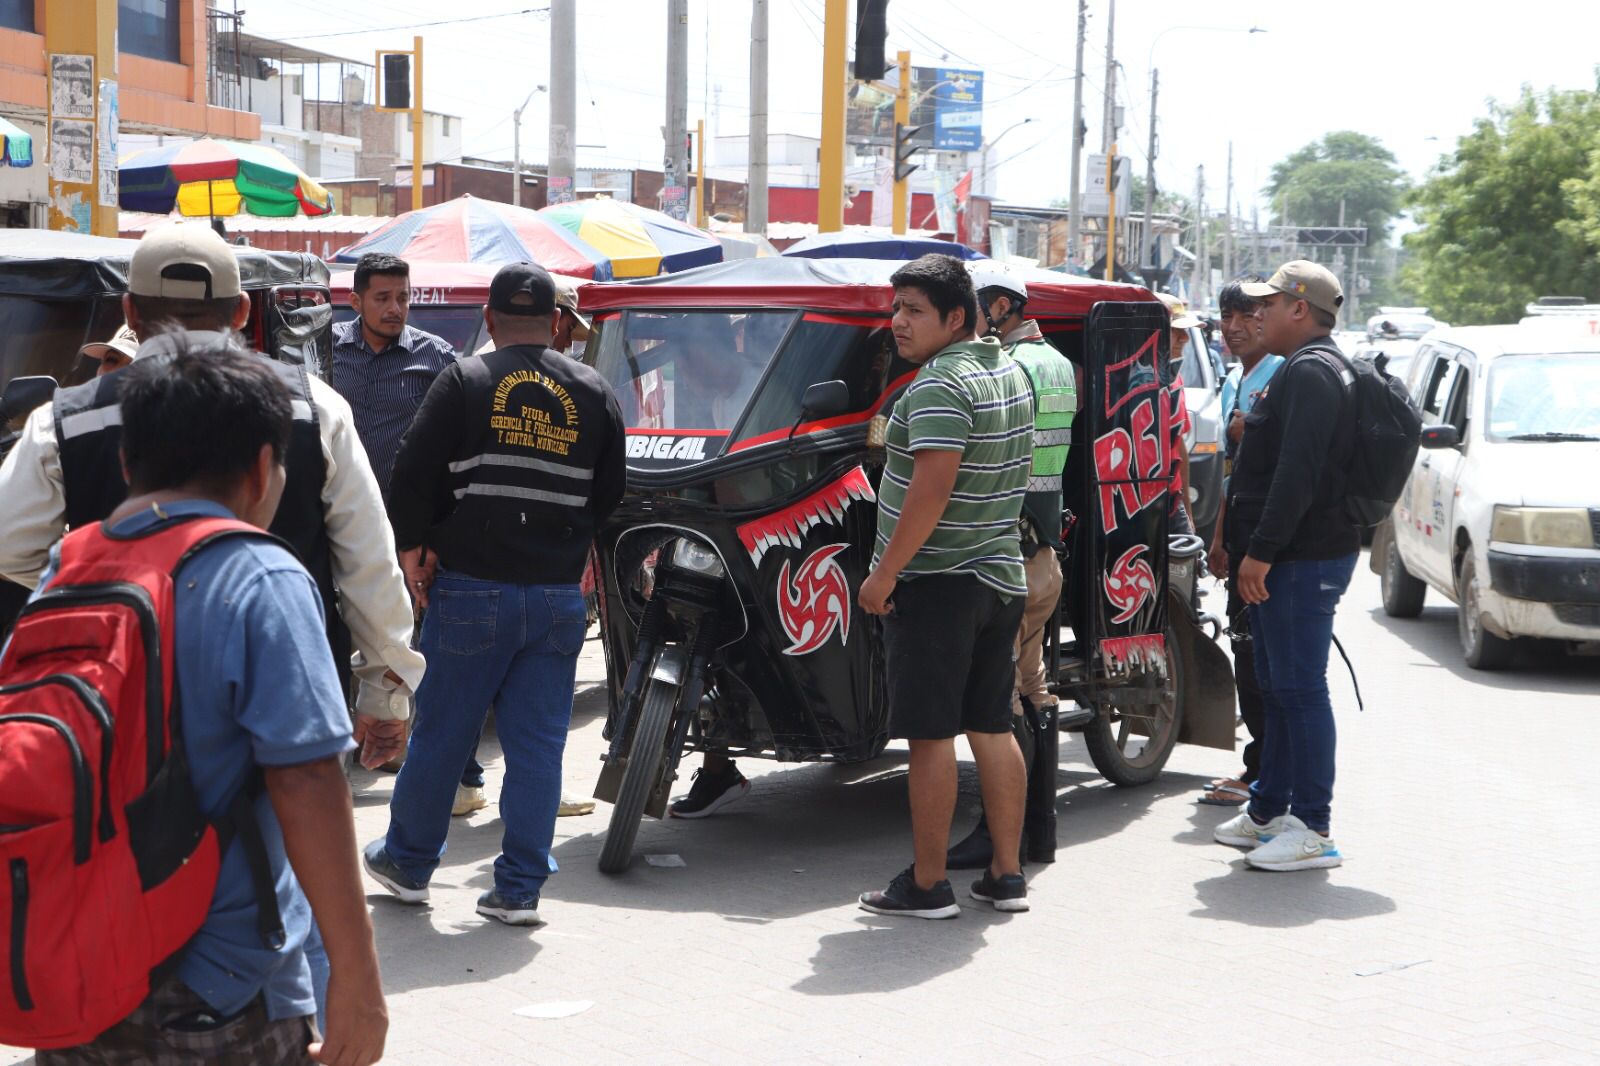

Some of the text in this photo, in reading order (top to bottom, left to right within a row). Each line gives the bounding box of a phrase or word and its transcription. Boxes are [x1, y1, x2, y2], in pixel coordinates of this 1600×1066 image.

[493, 370, 579, 426] MUNICIPALIDAD PROVINCIAL
[490, 416, 522, 431] GERENCIA
[525, 420, 533, 433] DE
[521, 406, 551, 423] PIURA
[498, 430, 570, 456] Y CONTROL MUNICIPAL
